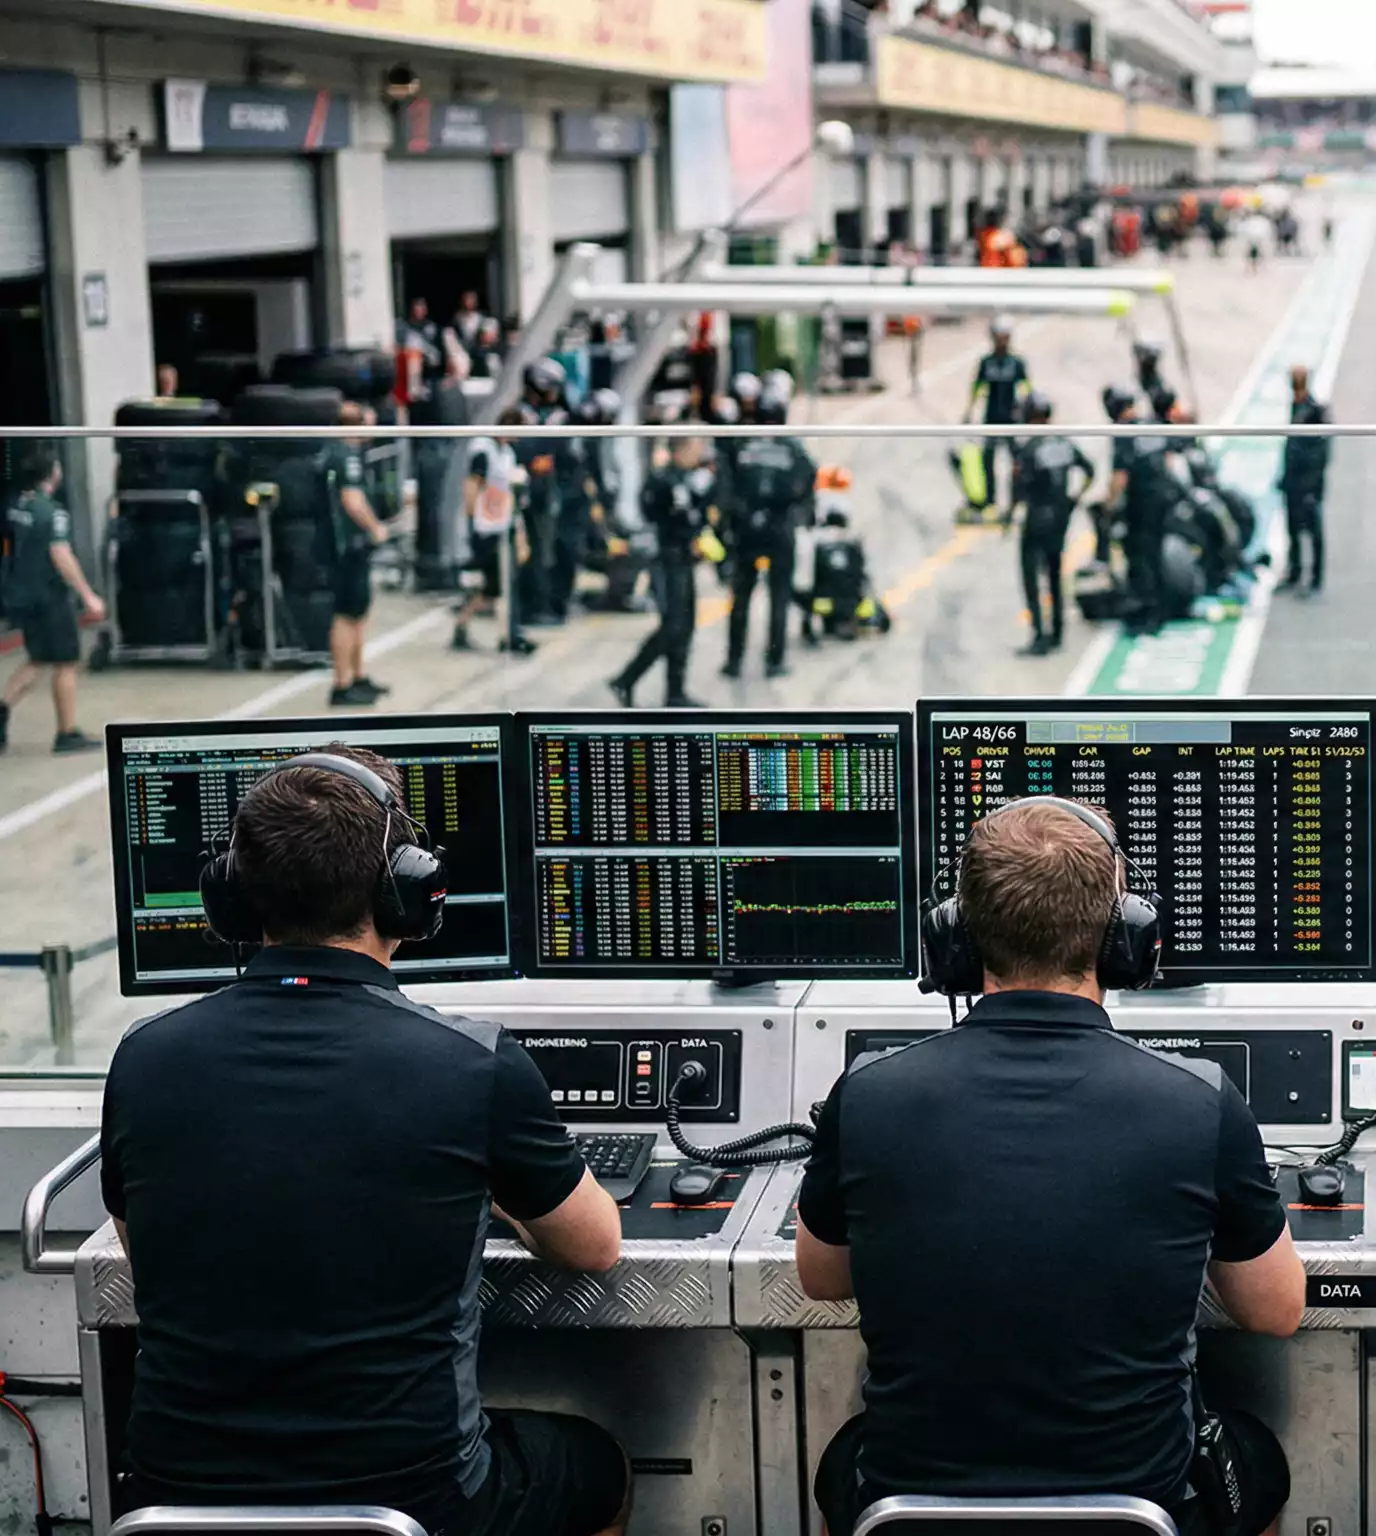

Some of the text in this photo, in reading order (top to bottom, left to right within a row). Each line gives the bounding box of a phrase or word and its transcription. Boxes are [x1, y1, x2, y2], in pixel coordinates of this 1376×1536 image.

[943, 726, 1016, 742] LAP 48/66
[943, 747, 961, 755] POS
[1079, 747, 1097, 755] CAR
[1133, 747, 1151, 755] GAP
[1179, 747, 1193, 755] INT
[1216, 747, 1232, 755] LAP
[1263, 747, 1284, 755] LAPS
[985, 760, 1005, 768] VST
[1346, 870, 1352, 878] 0
[1346, 882, 1352, 890] 0
[1346, 931, 1352, 939] 0
[1346, 943, 1352, 951] 0
[681, 1039, 708, 1048] DATA
[1321, 1285, 1361, 1297] DATA
